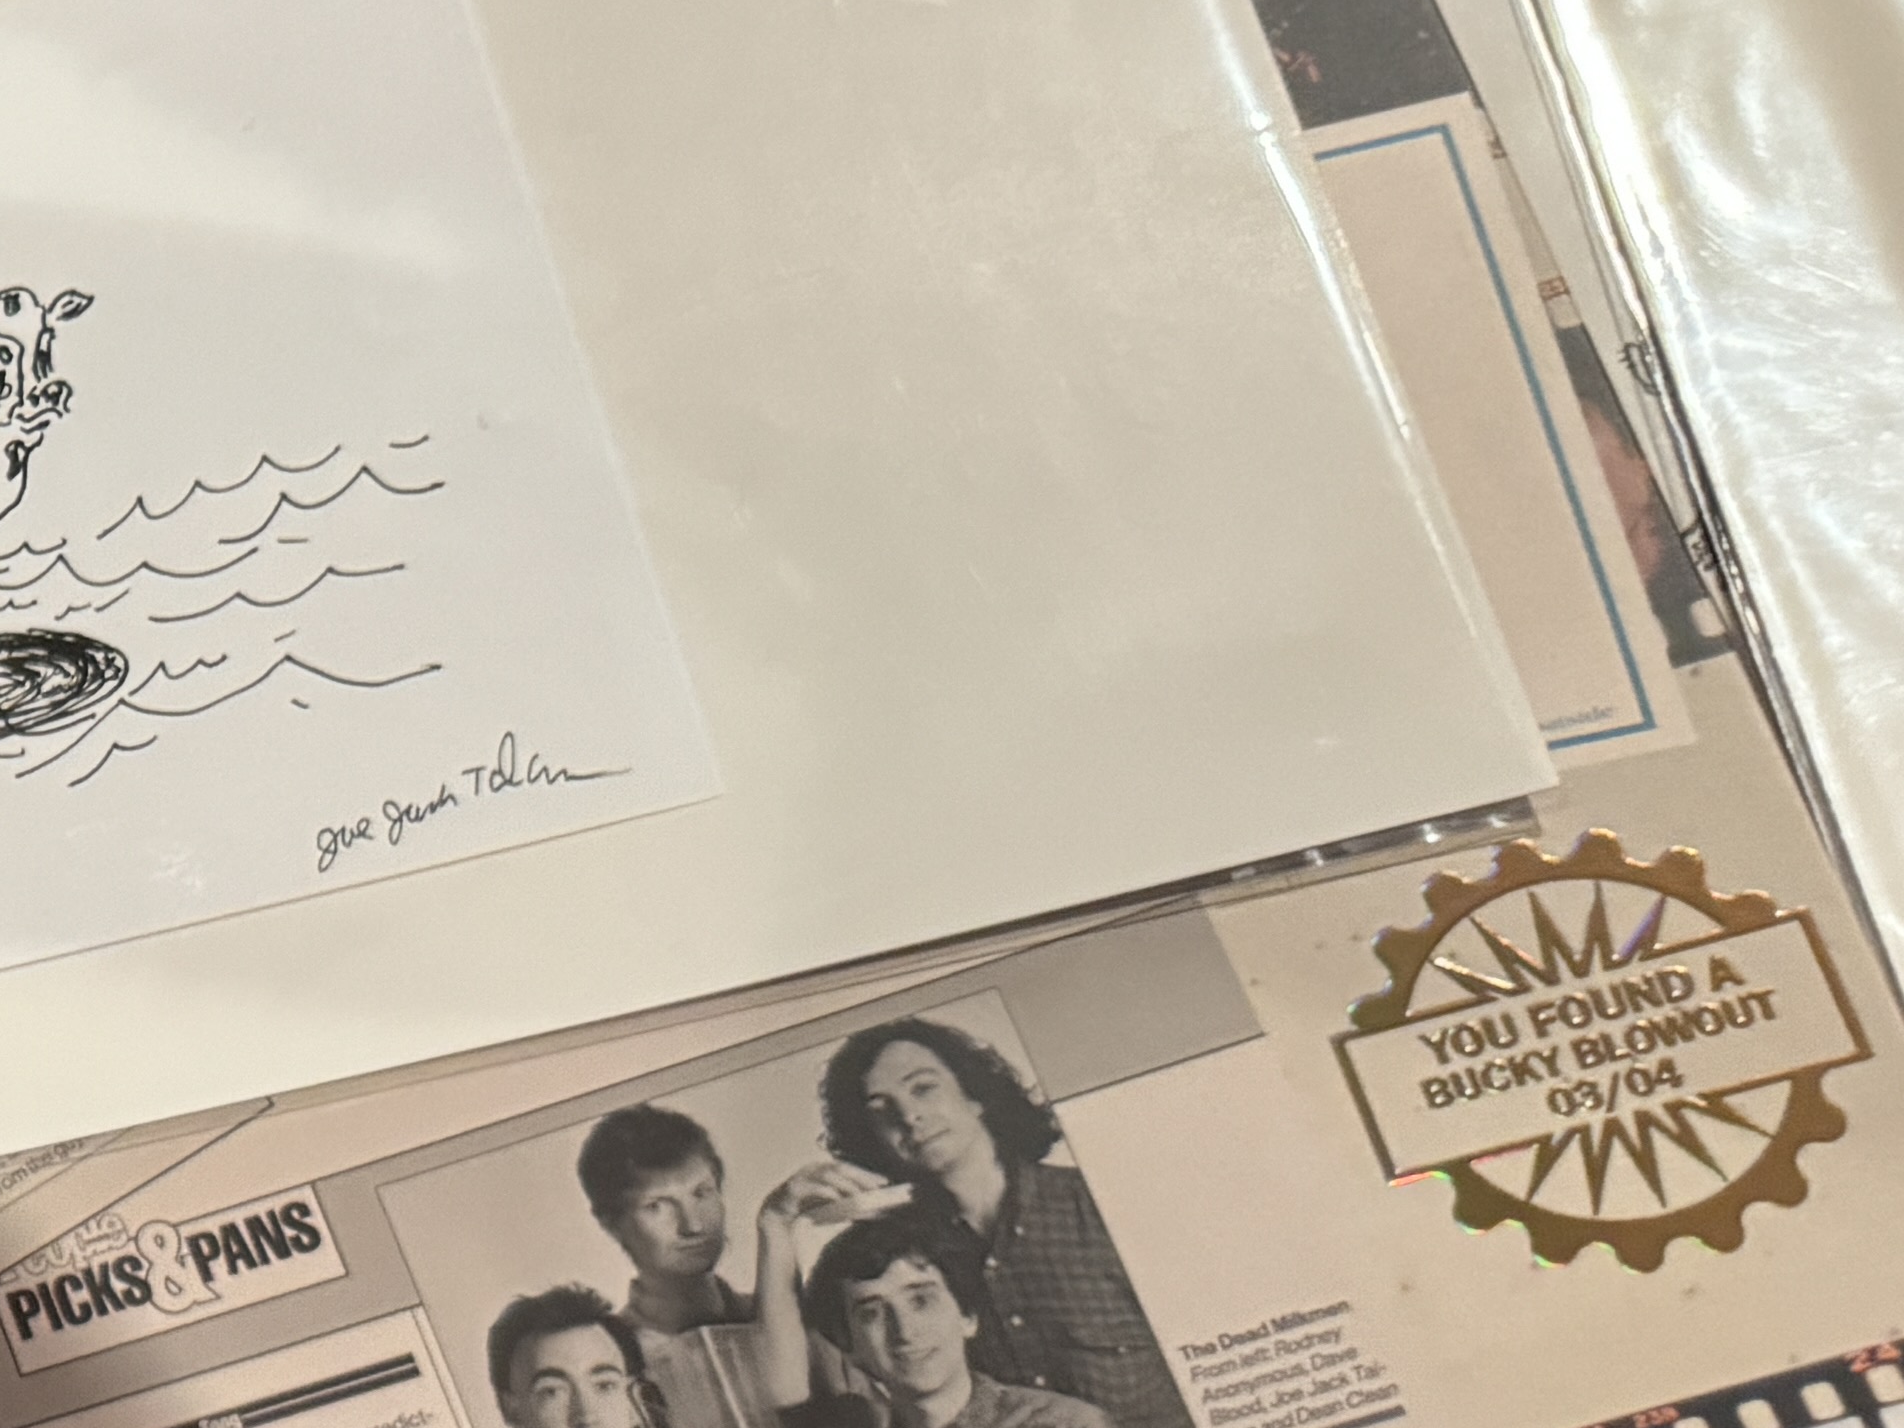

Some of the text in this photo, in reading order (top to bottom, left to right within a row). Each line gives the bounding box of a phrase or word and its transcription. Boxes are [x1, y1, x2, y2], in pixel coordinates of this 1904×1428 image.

[1419, 954, 1746, 1065] YOU FOUND A
[1419, 989, 1776, 1109] BUCKY BLOWOUT
[1547, 1057, 1683, 1117] 03/04
[5, 1254, 152, 1341] PICKS
[136, 1220, 221, 1315] &
[186, 1201, 322, 1283] PANS
